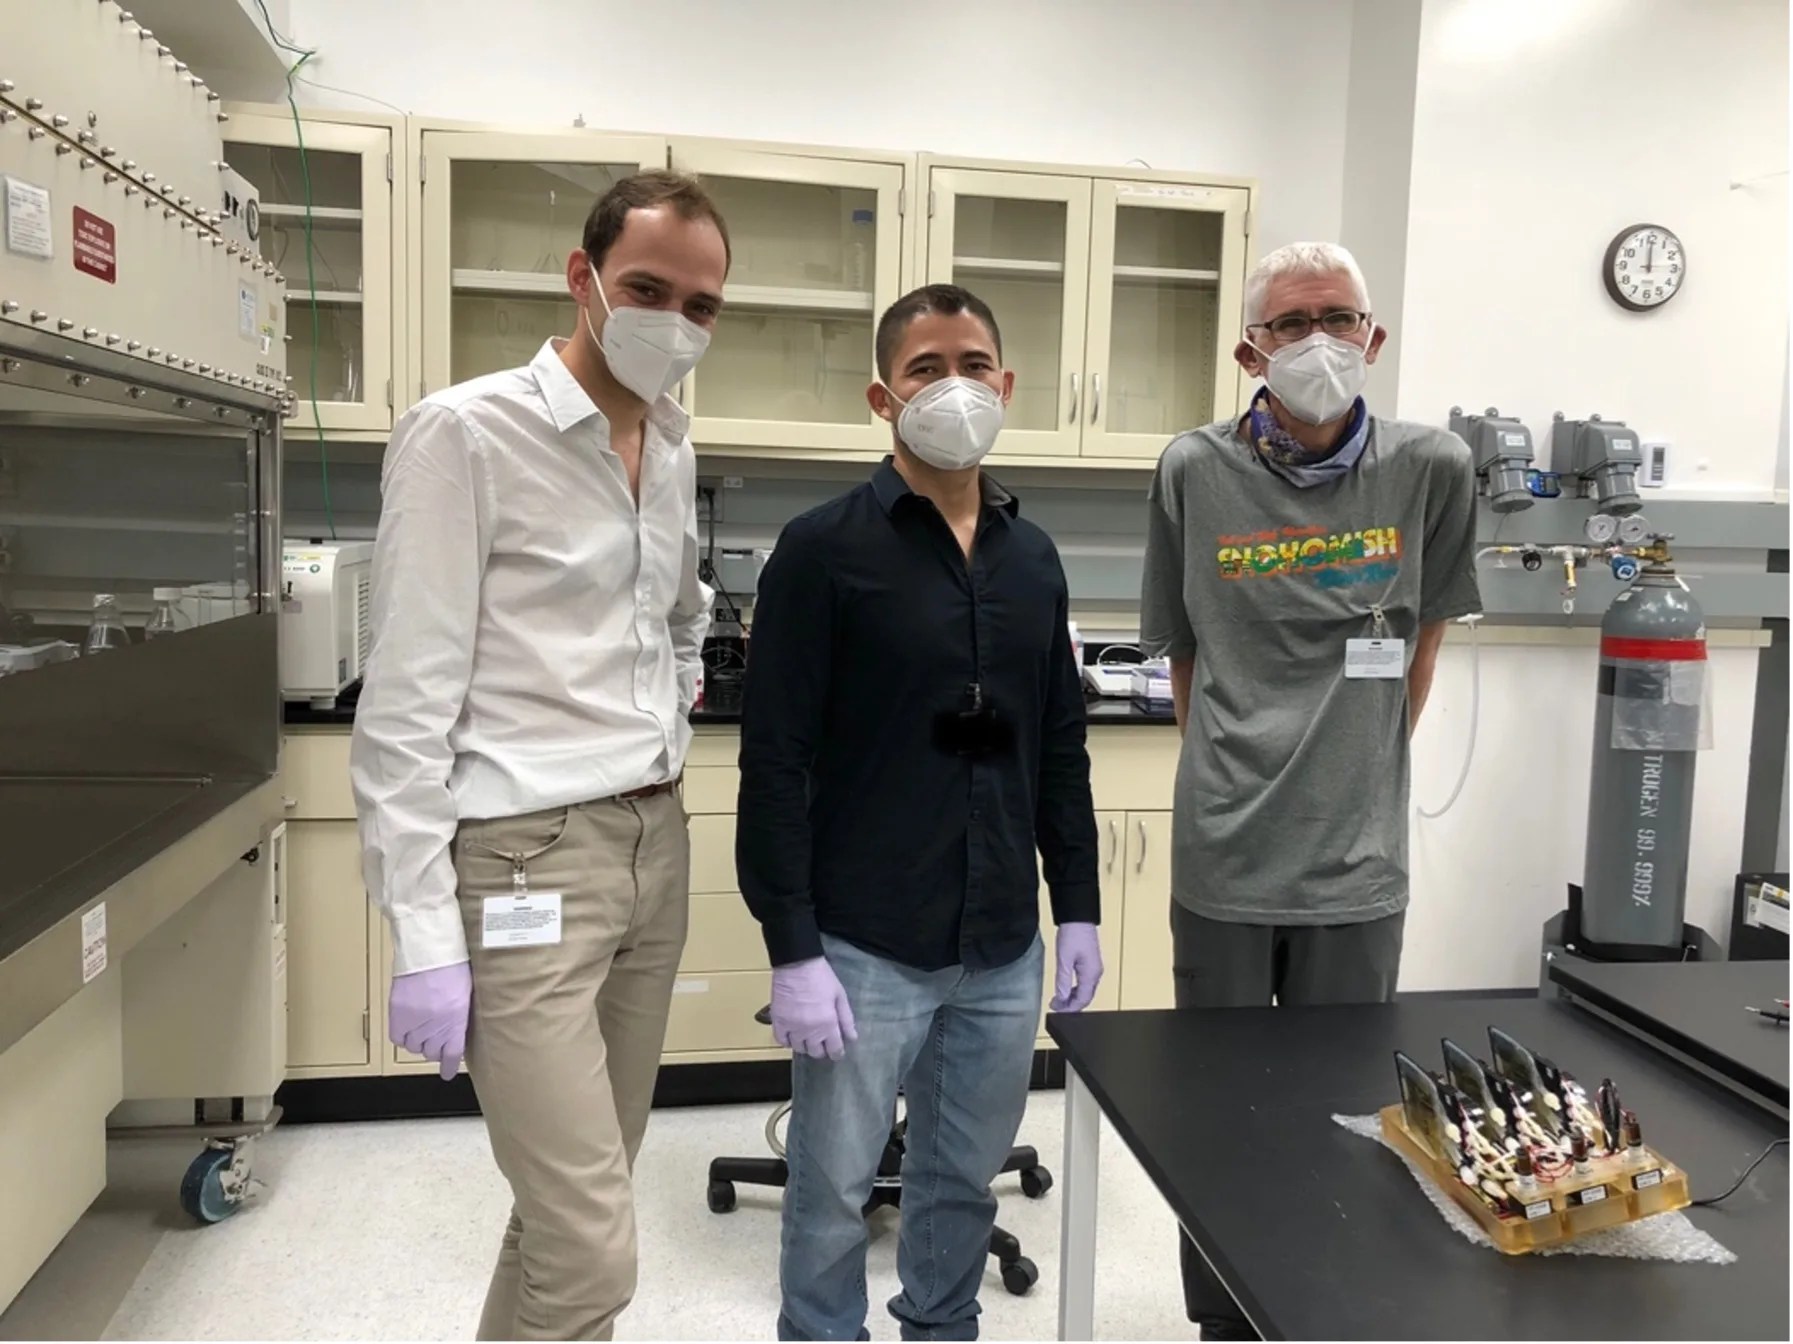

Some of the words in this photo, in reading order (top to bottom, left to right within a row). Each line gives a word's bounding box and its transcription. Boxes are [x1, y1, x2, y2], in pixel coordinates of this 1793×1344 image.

[1662, 240, 1667, 249] 1
[1624, 248, 1636, 258] 10
[1667, 250, 1676, 260] 2
[1619, 260, 1628, 270] 9
[1670, 264, 1678, 274] 3
[1622, 275, 1631, 285] 8
[1665, 278, 1672, 287] 4
[1631, 284, 1639, 294] 7
[1655, 286, 1664, 296] 5
[1642, 290, 1651, 299] 6
